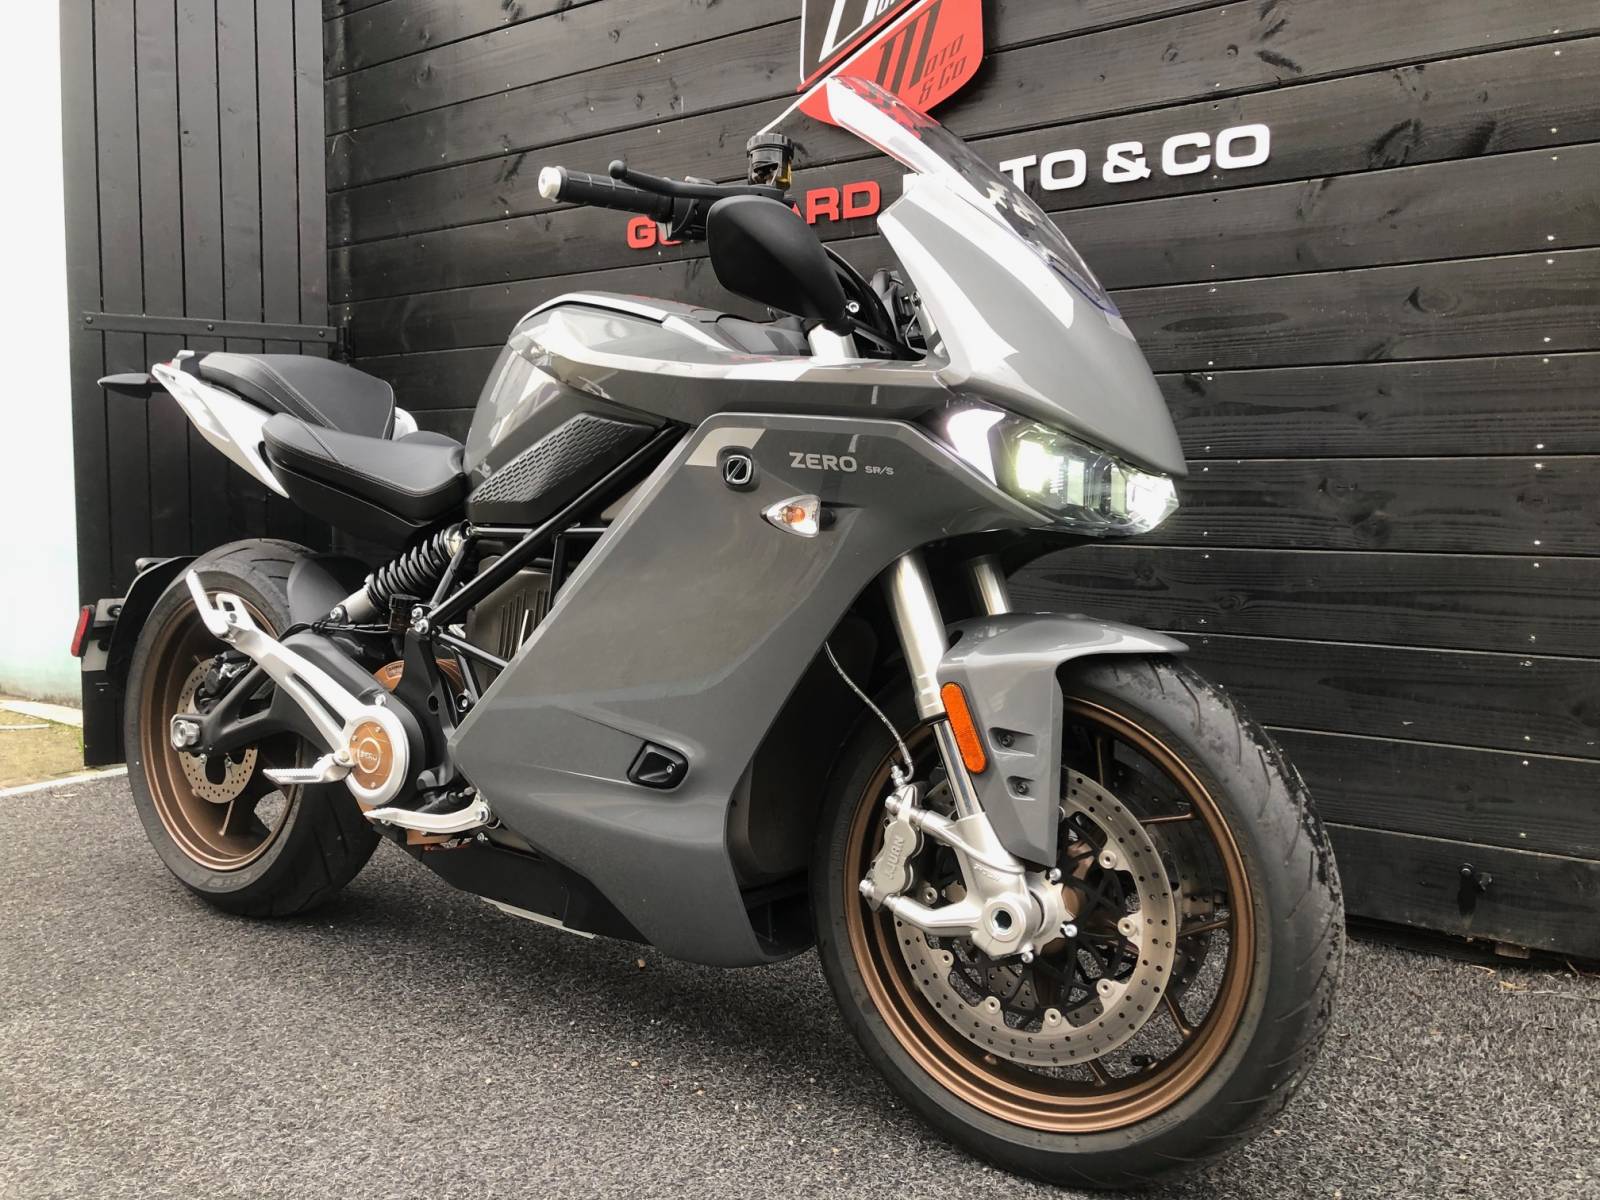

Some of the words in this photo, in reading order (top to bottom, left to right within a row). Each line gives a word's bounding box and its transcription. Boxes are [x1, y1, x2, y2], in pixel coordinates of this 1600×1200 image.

[1000, 148, 1087, 193] TO
[1102, 141, 1151, 183] &
[1162, 123, 1271, 176] CO
[789, 451, 857, 472] ZERO
[864, 465, 894, 476] SR/S
